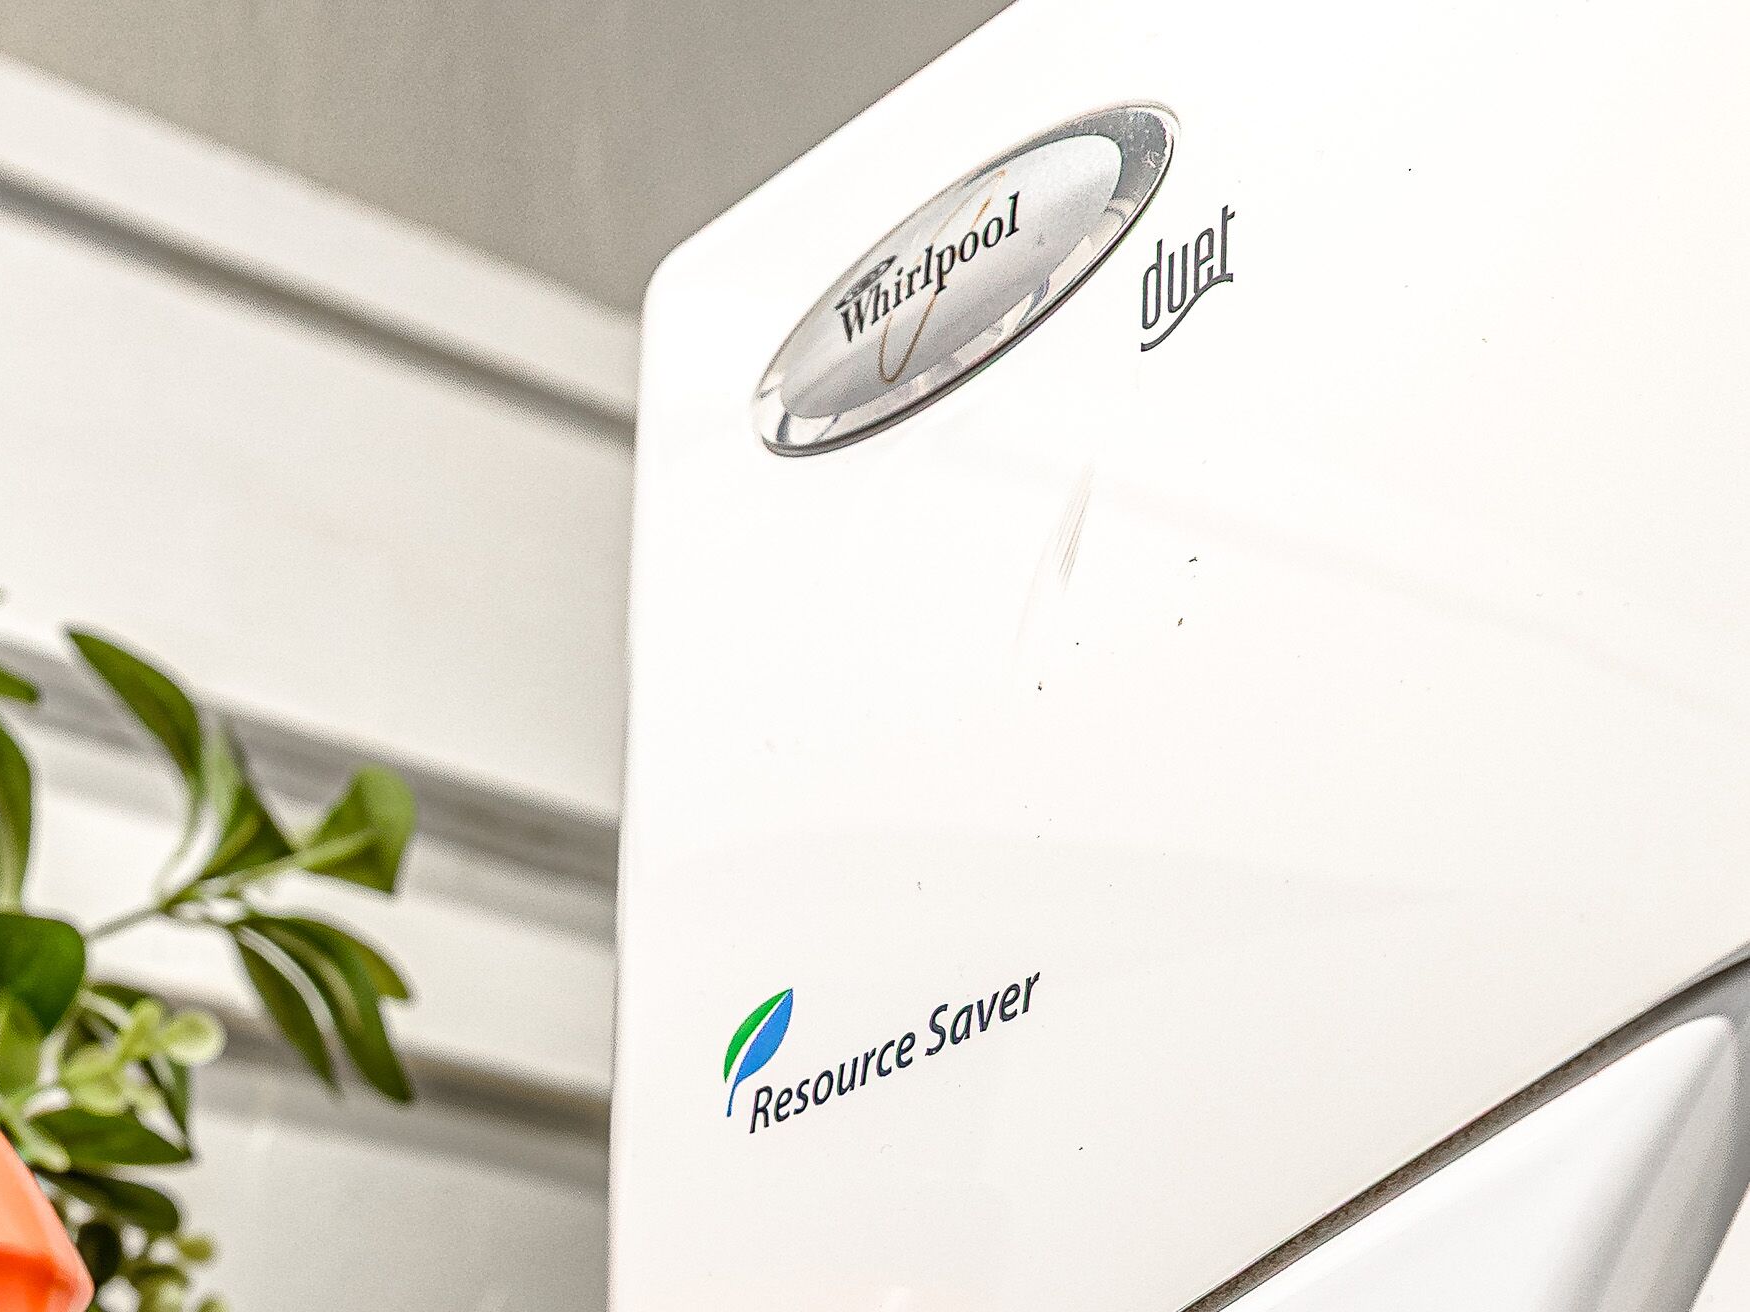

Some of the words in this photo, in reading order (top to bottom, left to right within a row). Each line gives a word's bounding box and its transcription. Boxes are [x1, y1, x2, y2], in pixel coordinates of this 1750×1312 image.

[840, 190, 1020, 343] Whirlpool
[1139, 204, 1236, 351] duet
[749, 1031, 916, 1134] Resource
[924, 971, 1041, 1057] Saver
